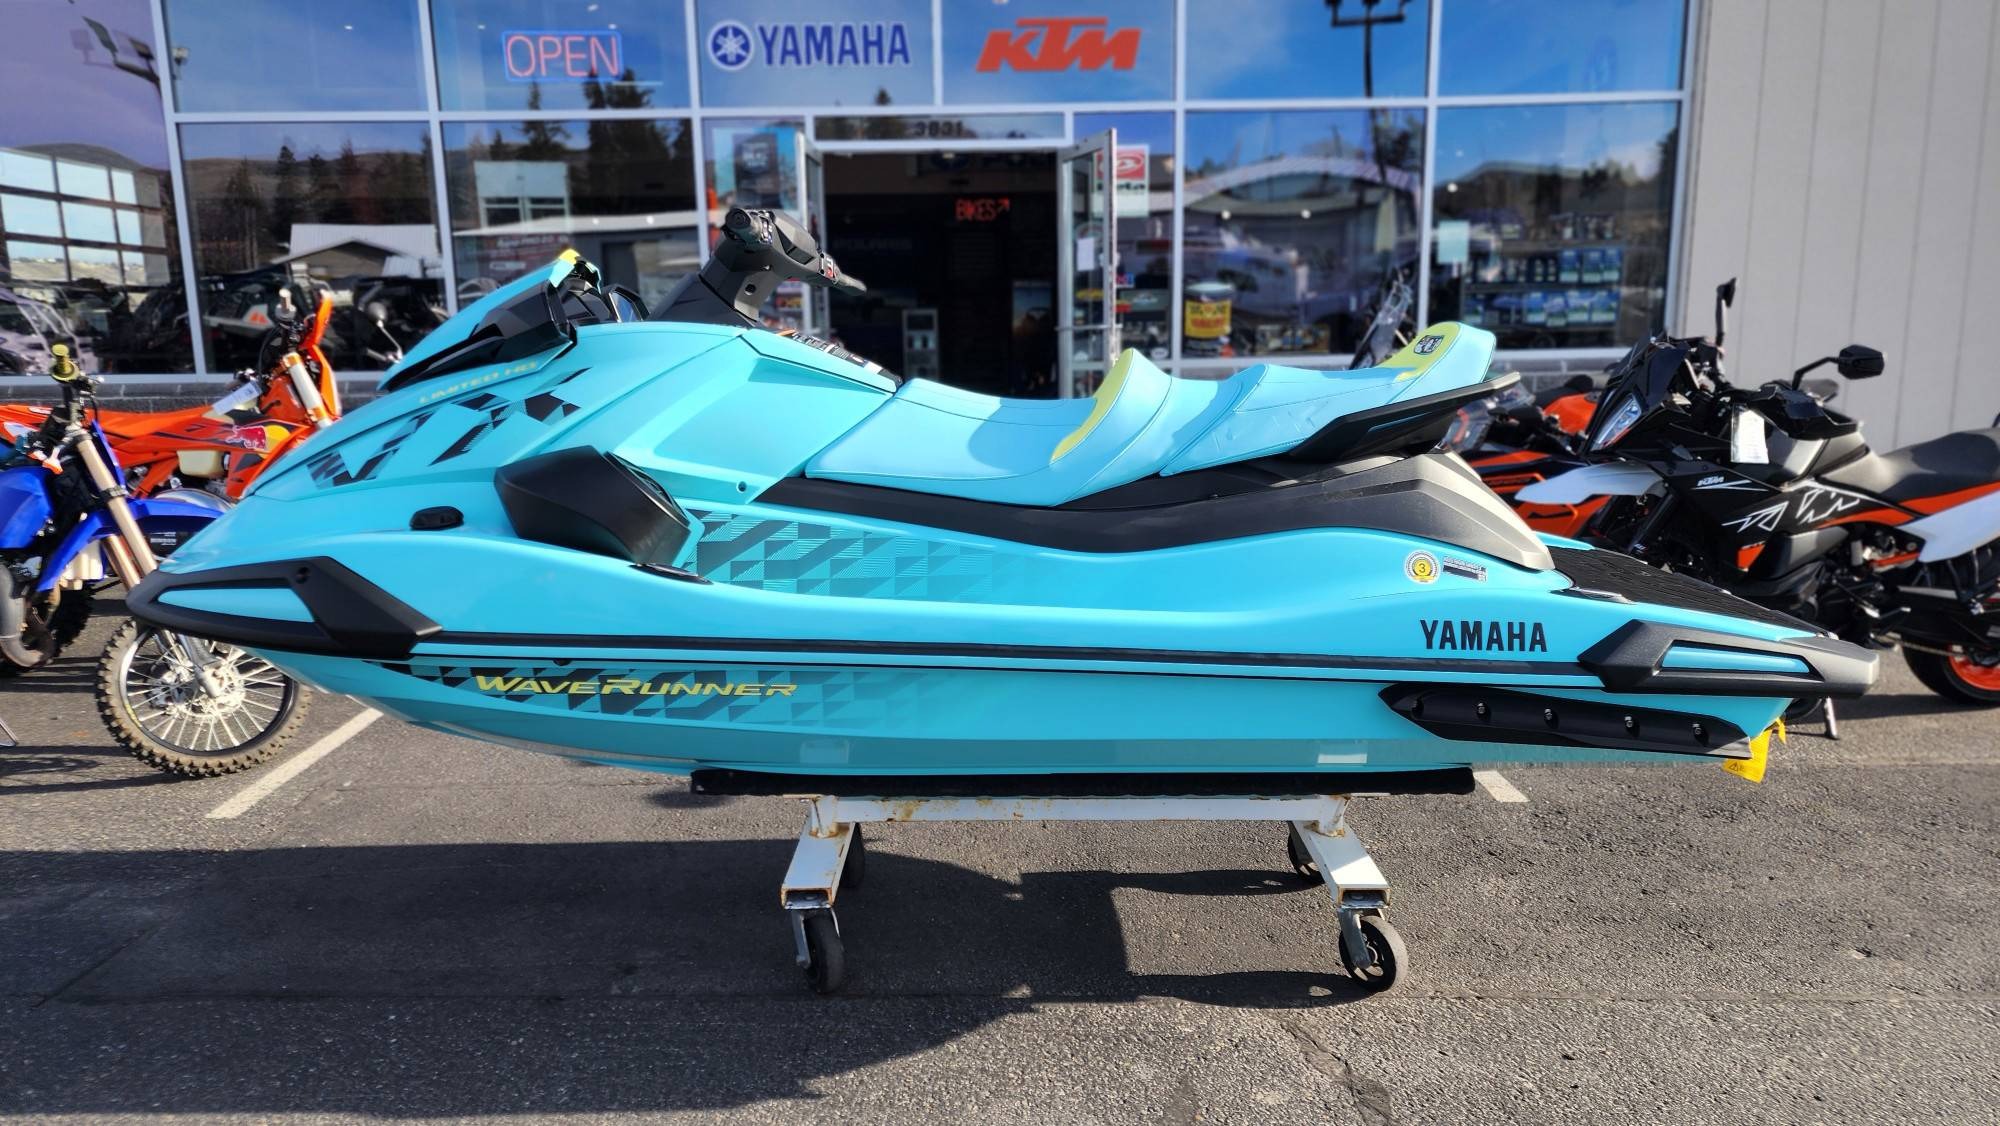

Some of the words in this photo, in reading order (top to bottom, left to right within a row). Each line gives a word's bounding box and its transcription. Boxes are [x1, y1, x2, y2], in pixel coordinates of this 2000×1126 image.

[506, 35, 618, 76] OPEN
[757, 24, 911, 66] YAMAHA
[976, 17, 1141, 72] KTM
[1418, 563, 1426, 574] 3
[1419, 619, 1547, 653] YAMAHA
